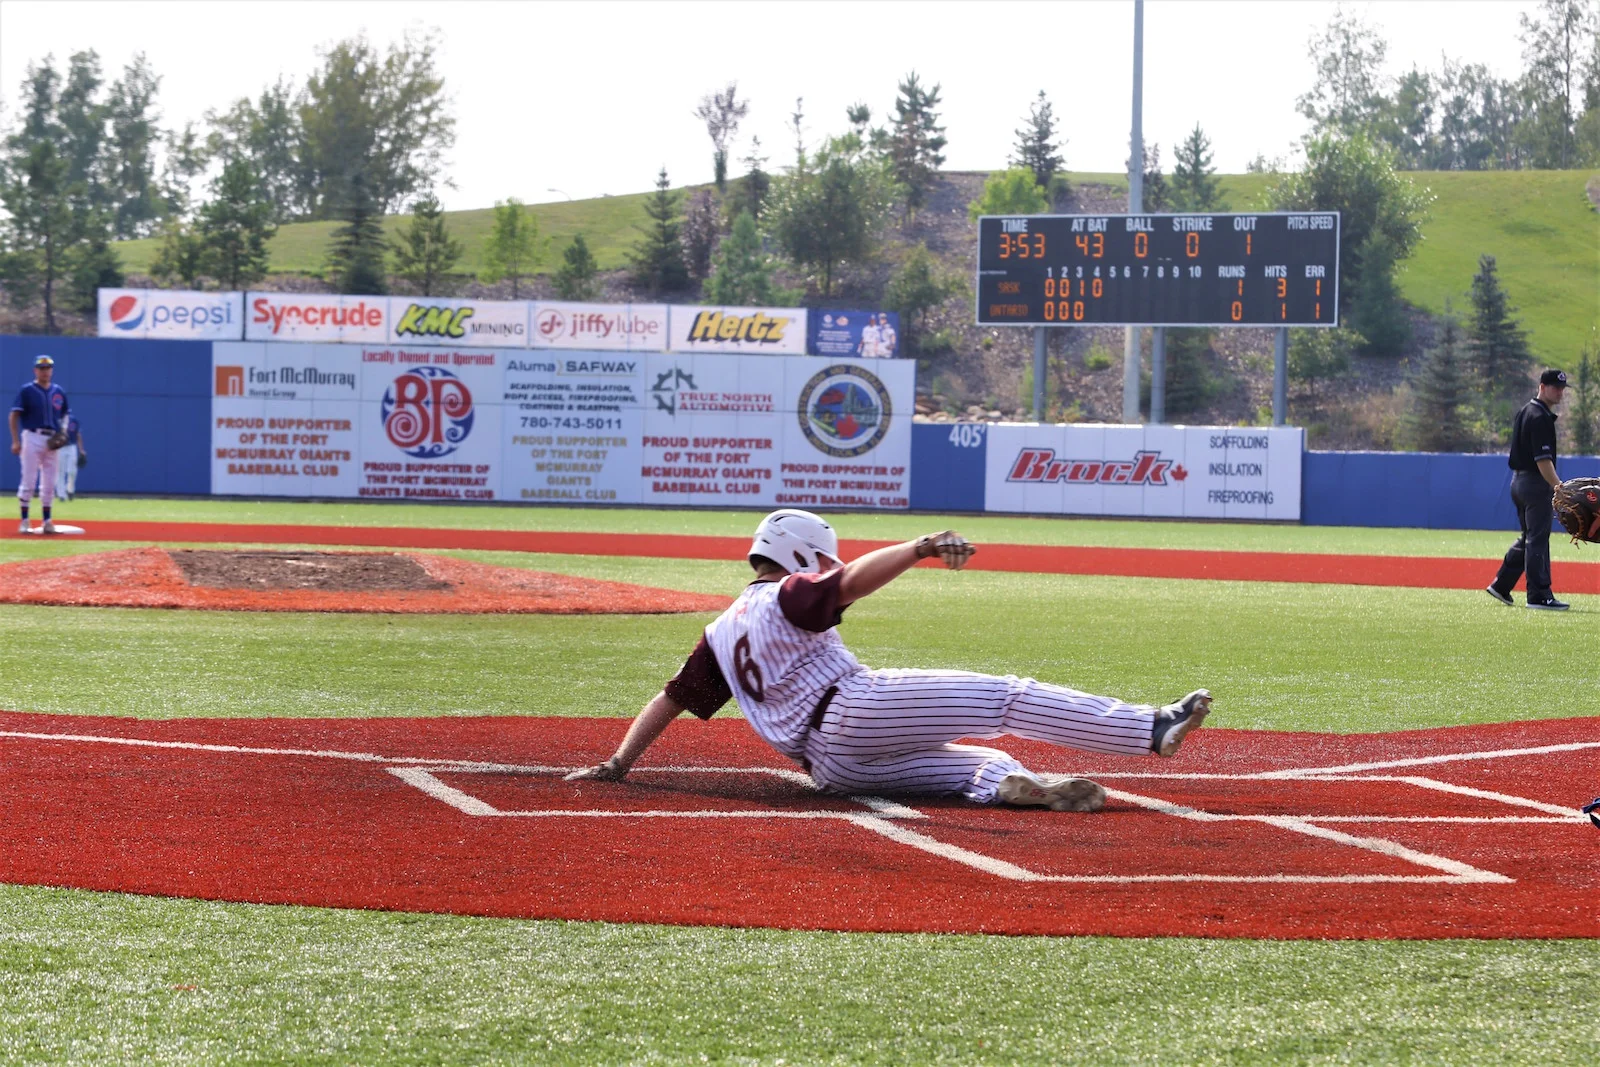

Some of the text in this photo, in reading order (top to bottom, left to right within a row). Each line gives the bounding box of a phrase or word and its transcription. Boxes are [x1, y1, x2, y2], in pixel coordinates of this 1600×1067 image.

[1002, 219, 1028, 232] TIME
[1071, 219, 1108, 232] AT BAT
[1126, 218, 1154, 231] BALL
[1173, 218, 1212, 231] STRIKE
[1234, 217, 1257, 230] OUT
[1288, 217, 1333, 229] PITCH SPEED
[999, 233, 1045, 258] 3:53
[1076, 233, 1103, 258] 43
[1135, 233, 1148, 258] 0
[1186, 232, 1199, 257] 0
[1246, 233, 1251, 255] 1
[1047, 266, 1201, 278] 1 2 3 4 5 6 7 8 9 10
[1219, 266, 1245, 277] RUNS
[1265, 266, 1287, 277] HITS
[1305, 265, 1325, 277] ERR
[1238, 279, 1243, 296] 1
[1277, 278, 1286, 297] 3
[153, 303, 232, 328] pepsi
[253, 298, 382, 334] Syncrude
[1232, 301, 1242, 320] 0
[396, 304, 524, 338] KMC MINING
[687, 311, 790, 344] Hertz
[363, 350, 494, 365] Locally Owned and Operated
[506, 360, 636, 372] Aluma SAFWAY
[249, 366, 355, 390] Fort McMurray
[679, 392, 772, 402] TRUE NORTH
[679, 403, 774, 412] AUTOMOTIVE
[216, 418, 351, 430] PROUD SUPPORTER
[520, 417, 622, 429] 780-743-5011
[239, 433, 328, 445] OF THE FORT
[512, 436, 627, 446] PROUD SUPPORTER
[642, 436, 772, 449] PROUD SUPPORTER
[1210, 436, 1268, 449] SCAFFOLDING
[216, 449, 351, 461] MCMURRAY GIANTS
[531, 449, 608, 459] OF THE FORT
[664, 452, 751, 464] OF THE FORT
[228, 464, 338, 476] BASEBALL CLUB
[364, 462, 490, 474] PROUD SUPPORTER OF
[642, 466, 772, 479] MCMURRAY GIANTS
[781, 464, 905, 476] PROUD SUPPORTER OF
[1005, 448, 1173, 485] Brock
[1209, 463, 1262, 476] INSULATION
[366, 475, 388, 484] THE
[391, 475, 420, 485] FORT
[547, 476, 591, 486] GIANTS
[782, 479, 805, 488] THE
[808, 480, 836, 489] FORT
[359, 487, 494, 499] GIANTS BASEBALL CLUB
[521, 489, 616, 499] BASEBALL CLUB
[652, 482, 760, 494] BASEBALL CLUB
[776, 494, 908, 506] GIANTS BASEBALL CLUB
[1208, 490, 1273, 504] FIREPROOFING
[733, 635, 764, 702] 6
